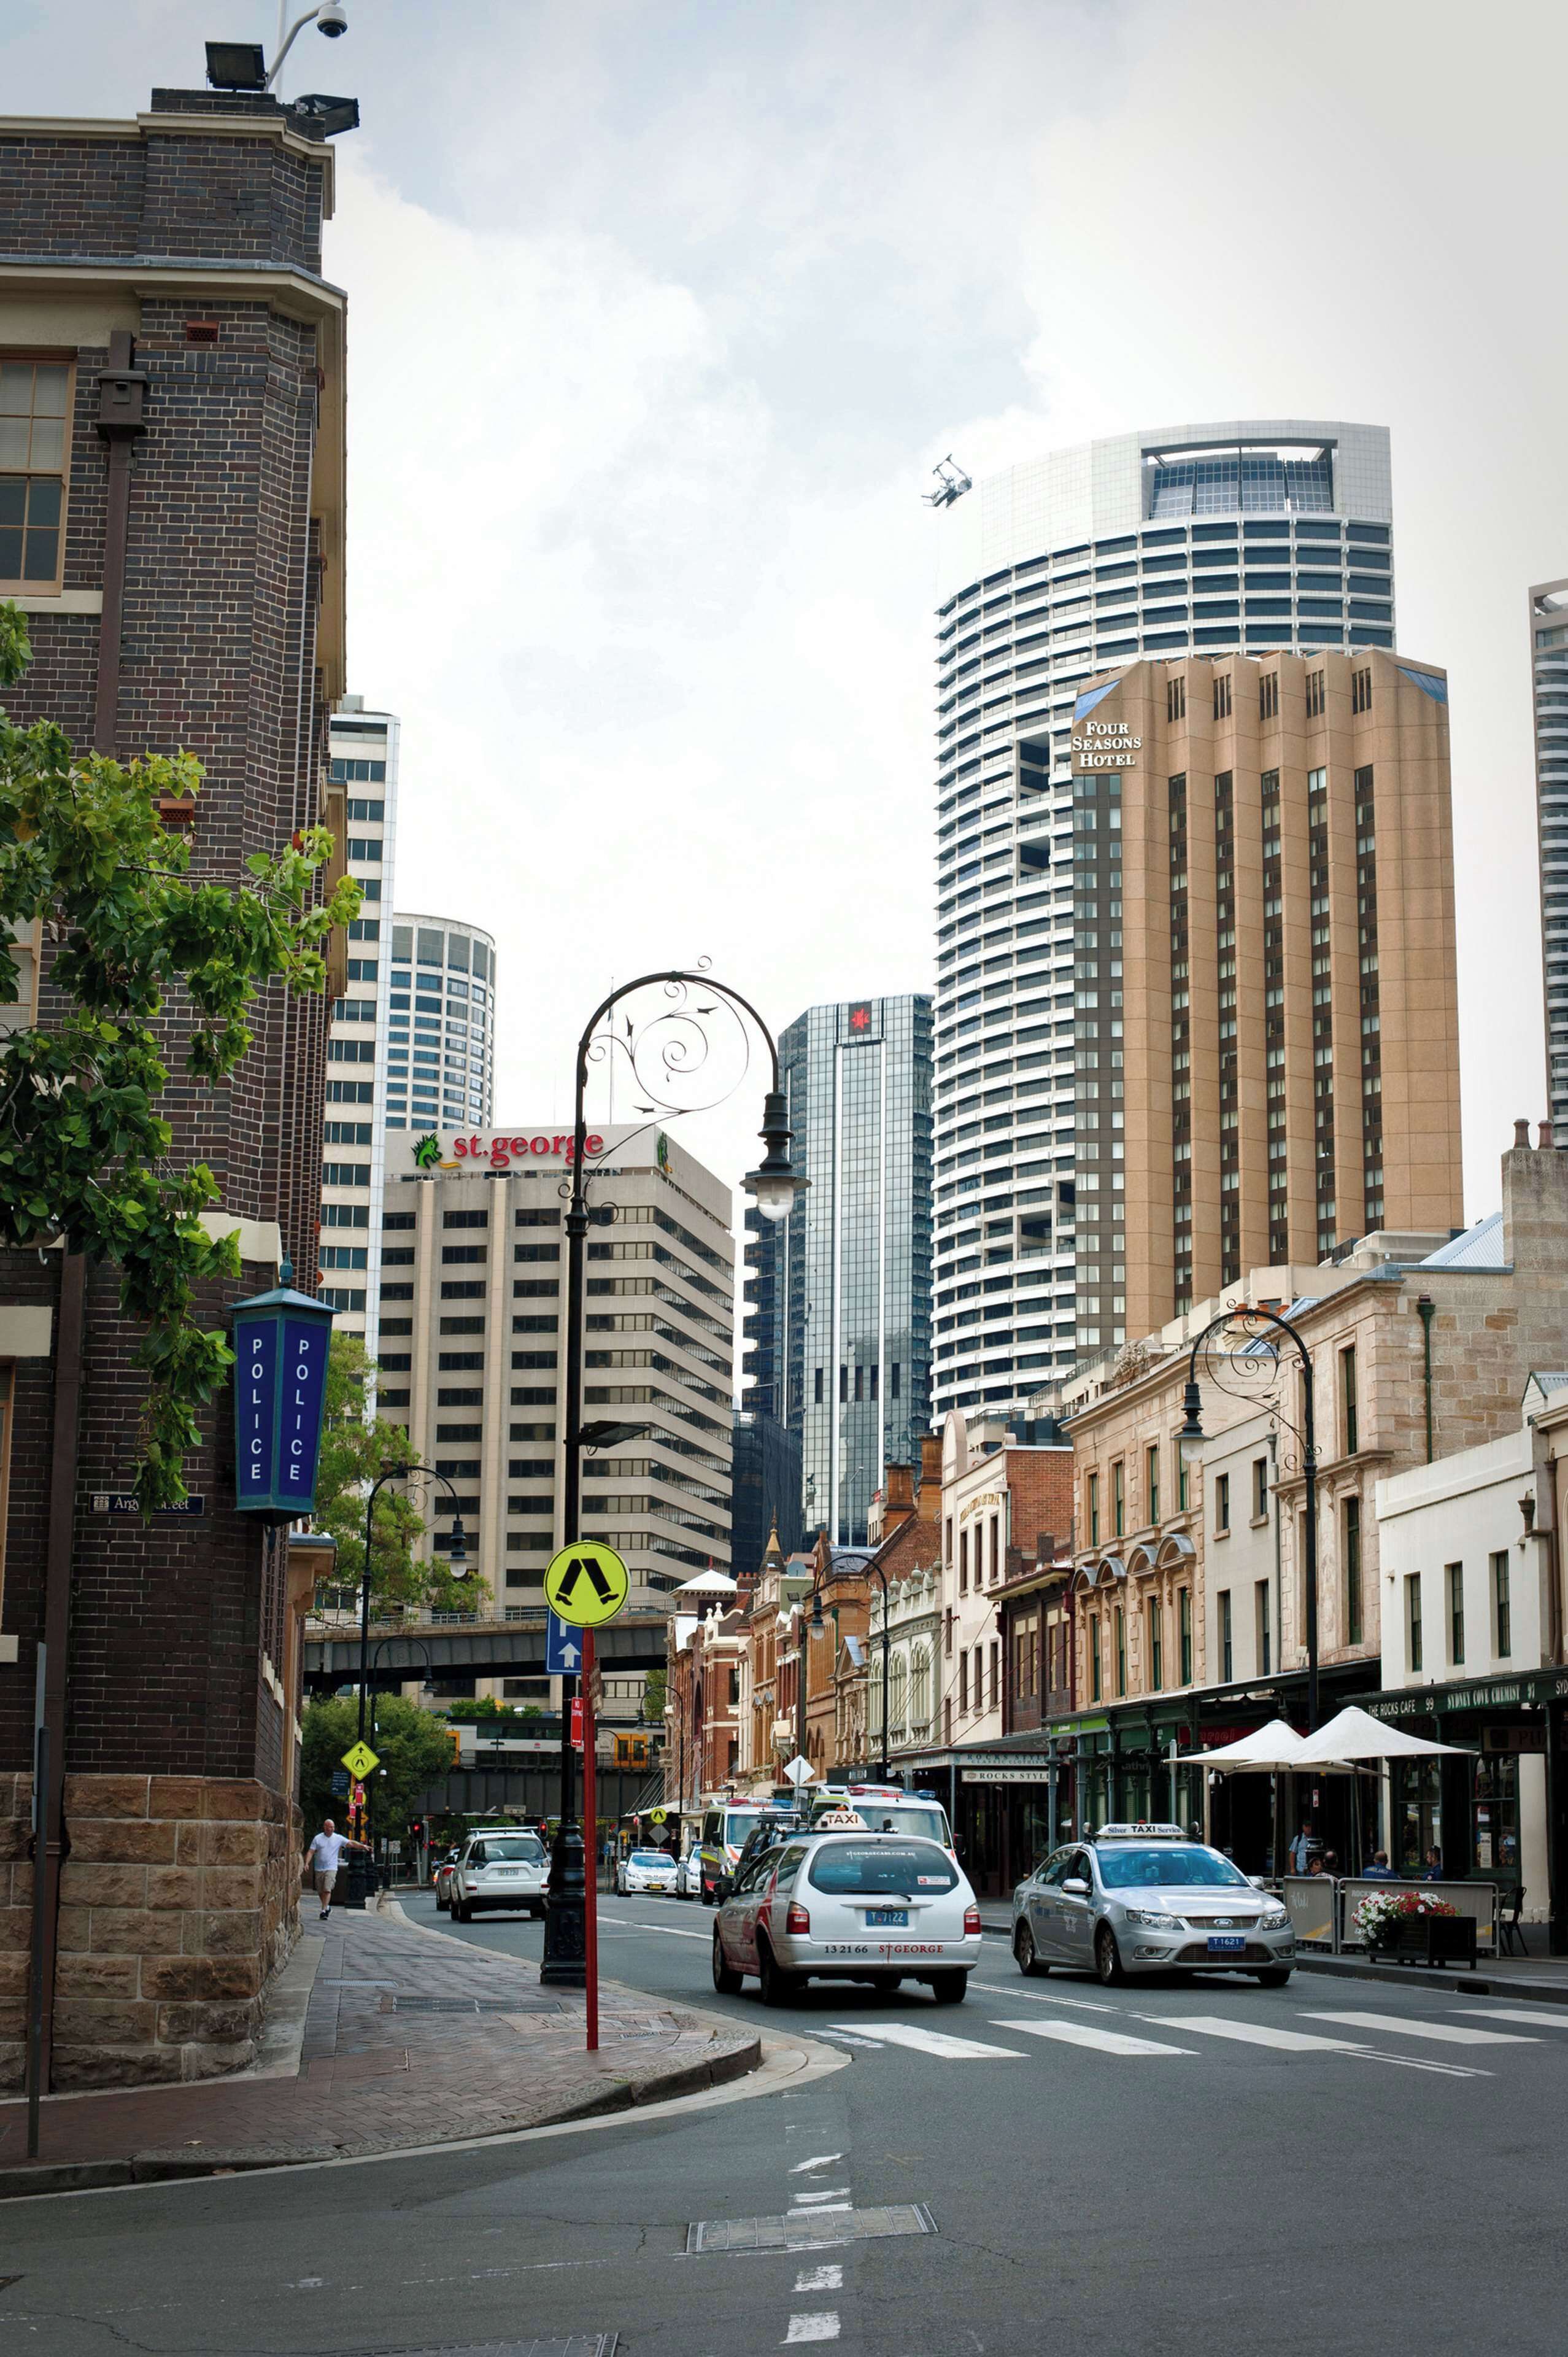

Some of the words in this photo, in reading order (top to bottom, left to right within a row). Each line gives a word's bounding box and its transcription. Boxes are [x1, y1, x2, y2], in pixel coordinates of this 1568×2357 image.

[1085, 721, 1129, 736] FOUR
[1072, 736, 1141, 752] SEASONS
[1079, 753, 1136, 767] HOTEL
[251, 1339, 263, 1479] POLICE
[290, 1339, 309, 1480] POLICE
[1447, 1691, 1471, 1709] SYDNEY
[1473, 1688, 1489, 1706] COVE
[1491, 1684, 1521, 1704] CHEMIST
[1369, 1704, 1378, 1717] THE
[1381, 1701, 1399, 1716] ROCKS
[1400, 1698, 1416, 1714] CAFE
[1426, 1697, 1434, 1711] 99
[826, 1814, 858, 1824] TAXI
